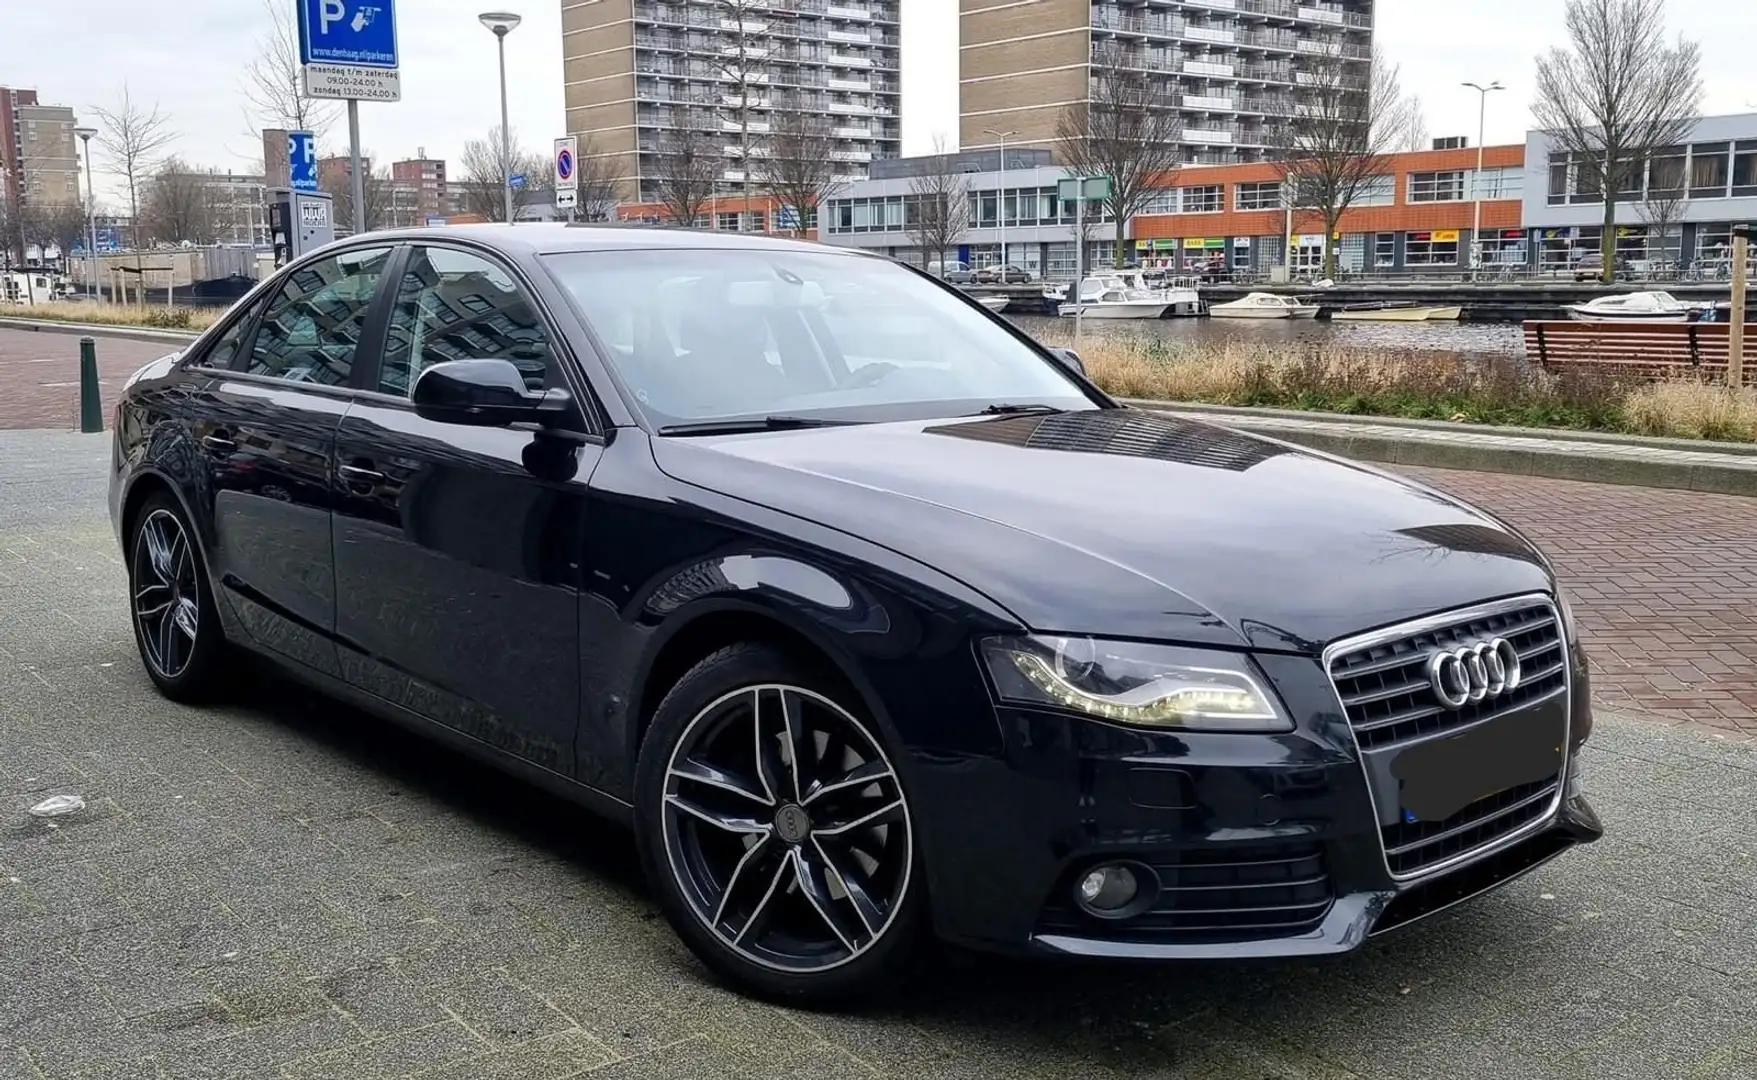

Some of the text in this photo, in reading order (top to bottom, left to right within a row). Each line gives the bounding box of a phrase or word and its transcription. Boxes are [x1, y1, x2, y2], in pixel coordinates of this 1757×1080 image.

[320, 0, 345, 34] P
[310, 65, 398, 80] maandag t/m zaterdag
[327, 76, 376, 87] 09.00-24.00
[313, 86, 341, 96] zondag
[343, 87, 390, 98] 13.00-24.00
